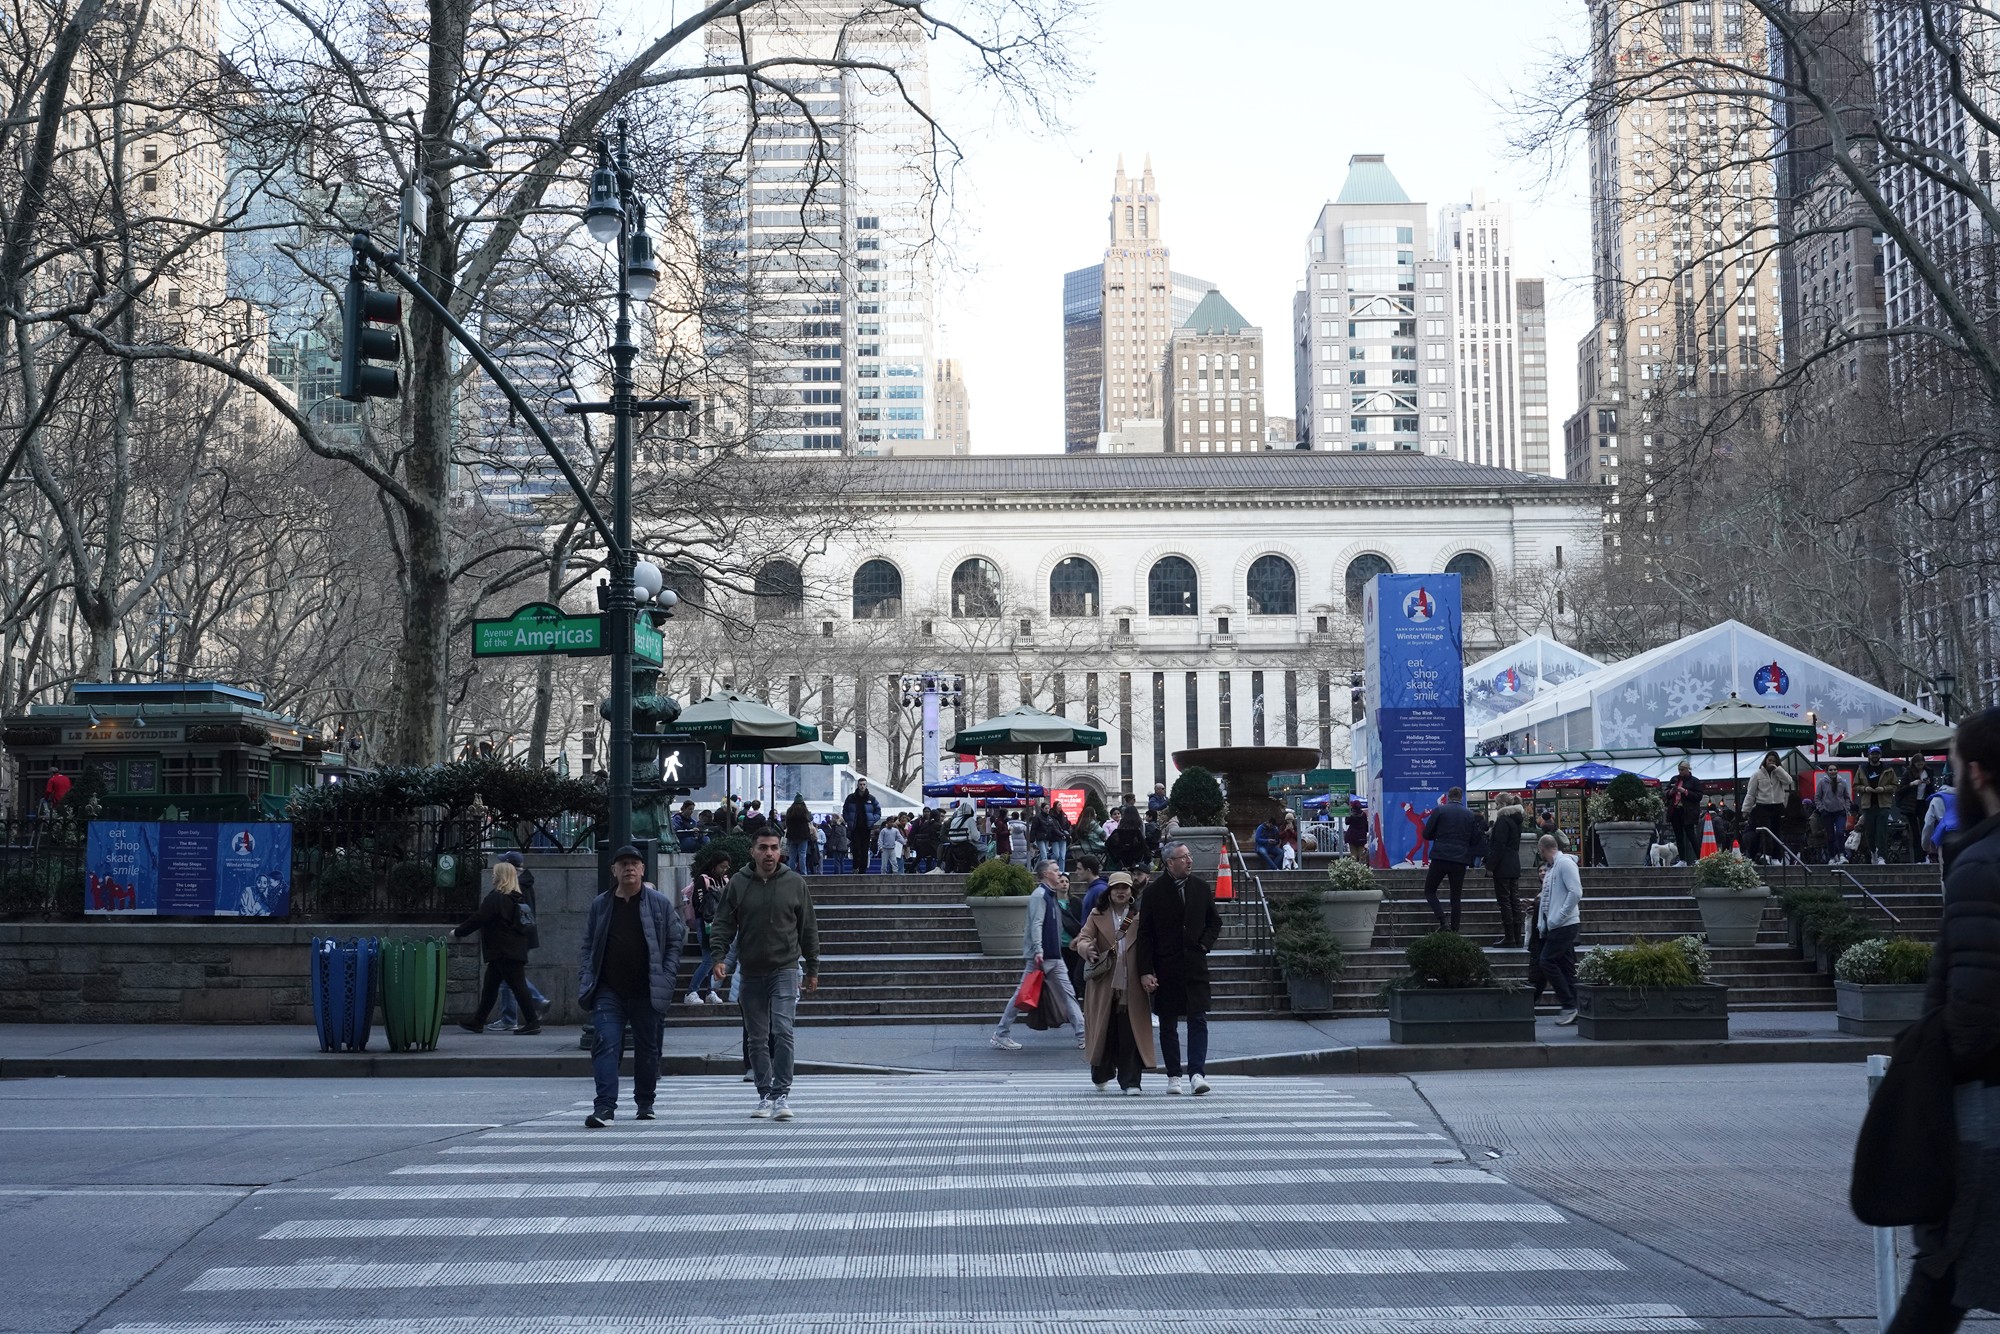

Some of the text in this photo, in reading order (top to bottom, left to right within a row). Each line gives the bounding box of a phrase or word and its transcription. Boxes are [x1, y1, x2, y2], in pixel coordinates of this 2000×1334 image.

[484, 628, 514, 638] Avenue
[514, 625, 594, 646] Americas
[1420, 633, 1444, 641] Village
[484, 638, 508, 648] of the
[655, 638, 661, 657] St
[1408, 659, 1424, 667] eat
[1414, 669, 1438, 680] shop
[1406, 679, 1434, 689] skate
[1414, 690, 1439, 700] smile
[68, 730, 178, 740] LE PAIN QUOTIDIEN
[109, 829, 126, 838] eat
[114, 840, 140, 852] shop
[106, 852, 134, 862] skate
[113, 865, 139, 875] smile
